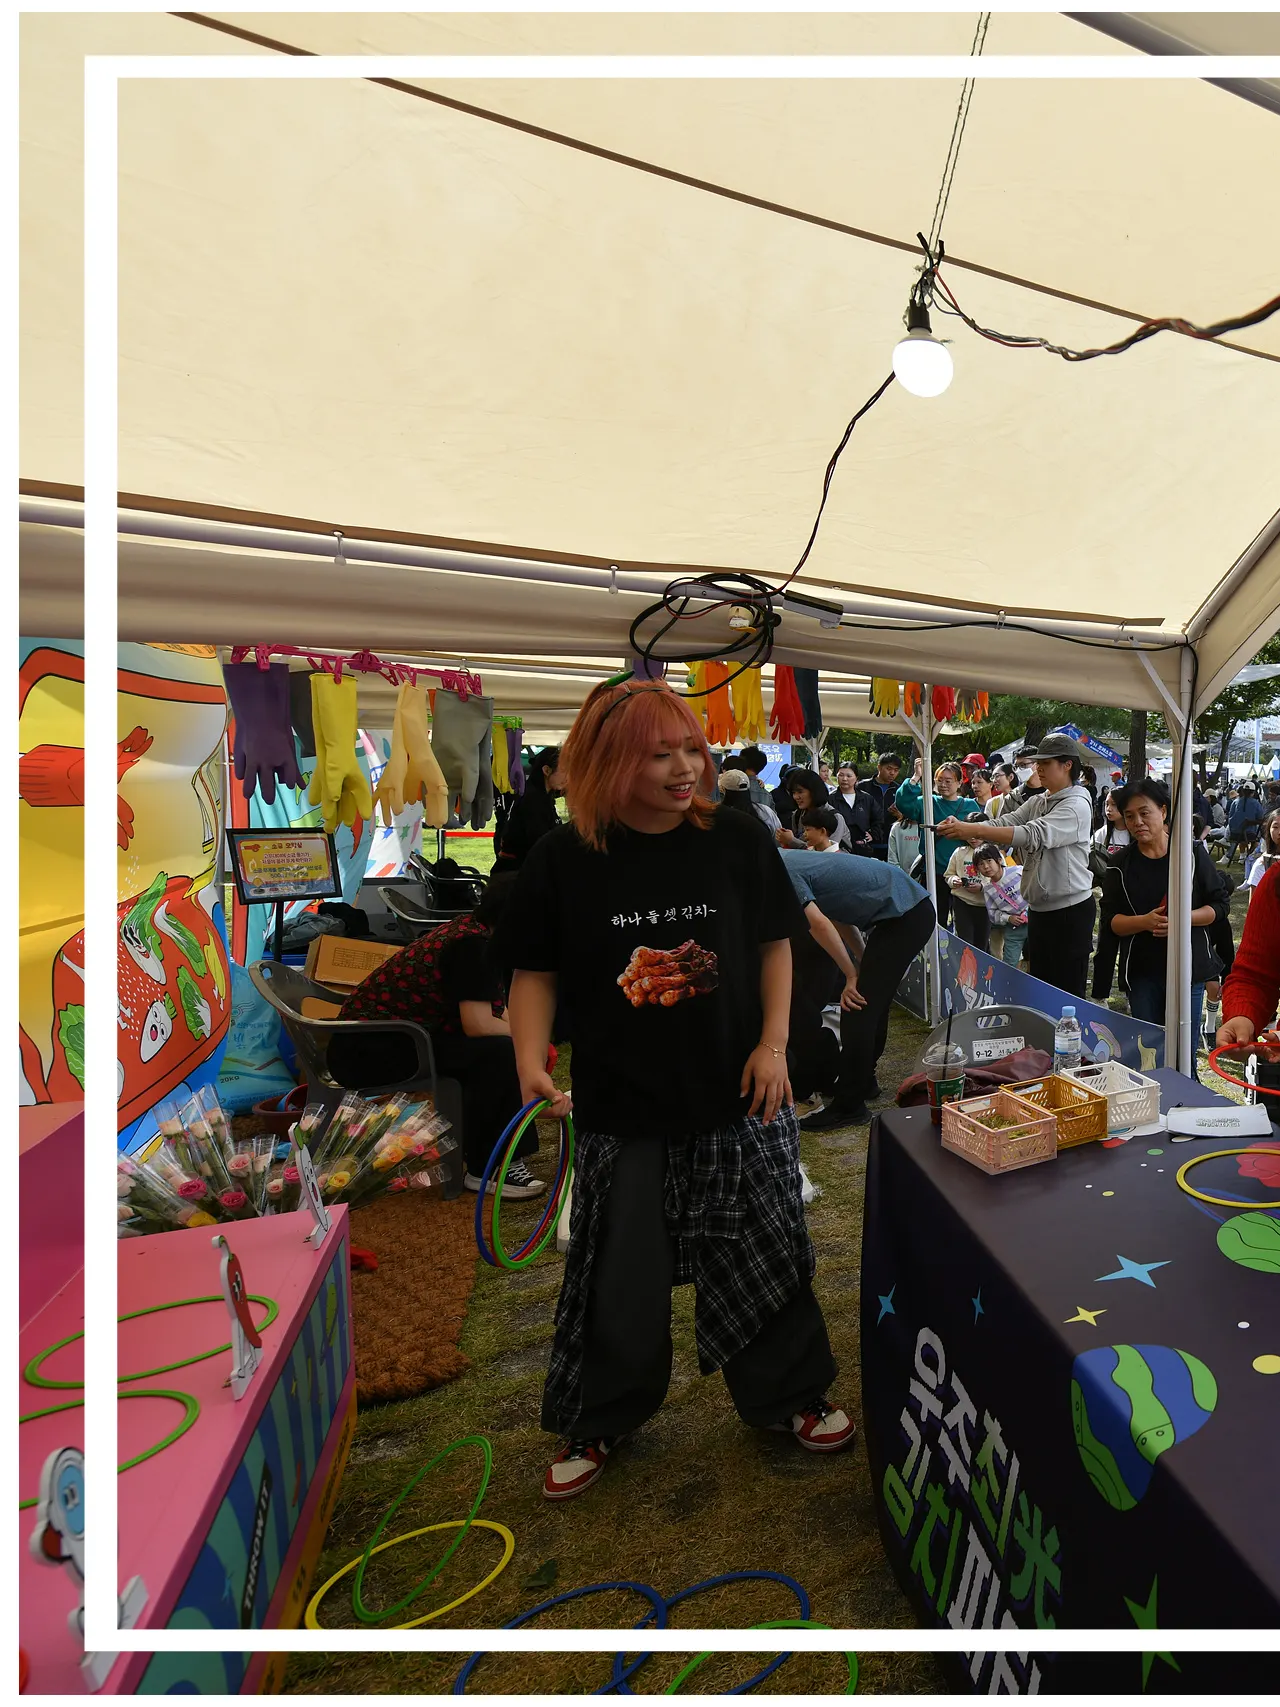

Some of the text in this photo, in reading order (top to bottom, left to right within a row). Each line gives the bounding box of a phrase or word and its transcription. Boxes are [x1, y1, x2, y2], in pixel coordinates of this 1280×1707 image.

[611, 912, 642, 928] 하나
[645, 909, 660, 925] 둘
[663, 907, 677, 922] 셋
[975, 1049, 993, 1058] 9-12
[244, 1480, 270, 1610] THROW IT
